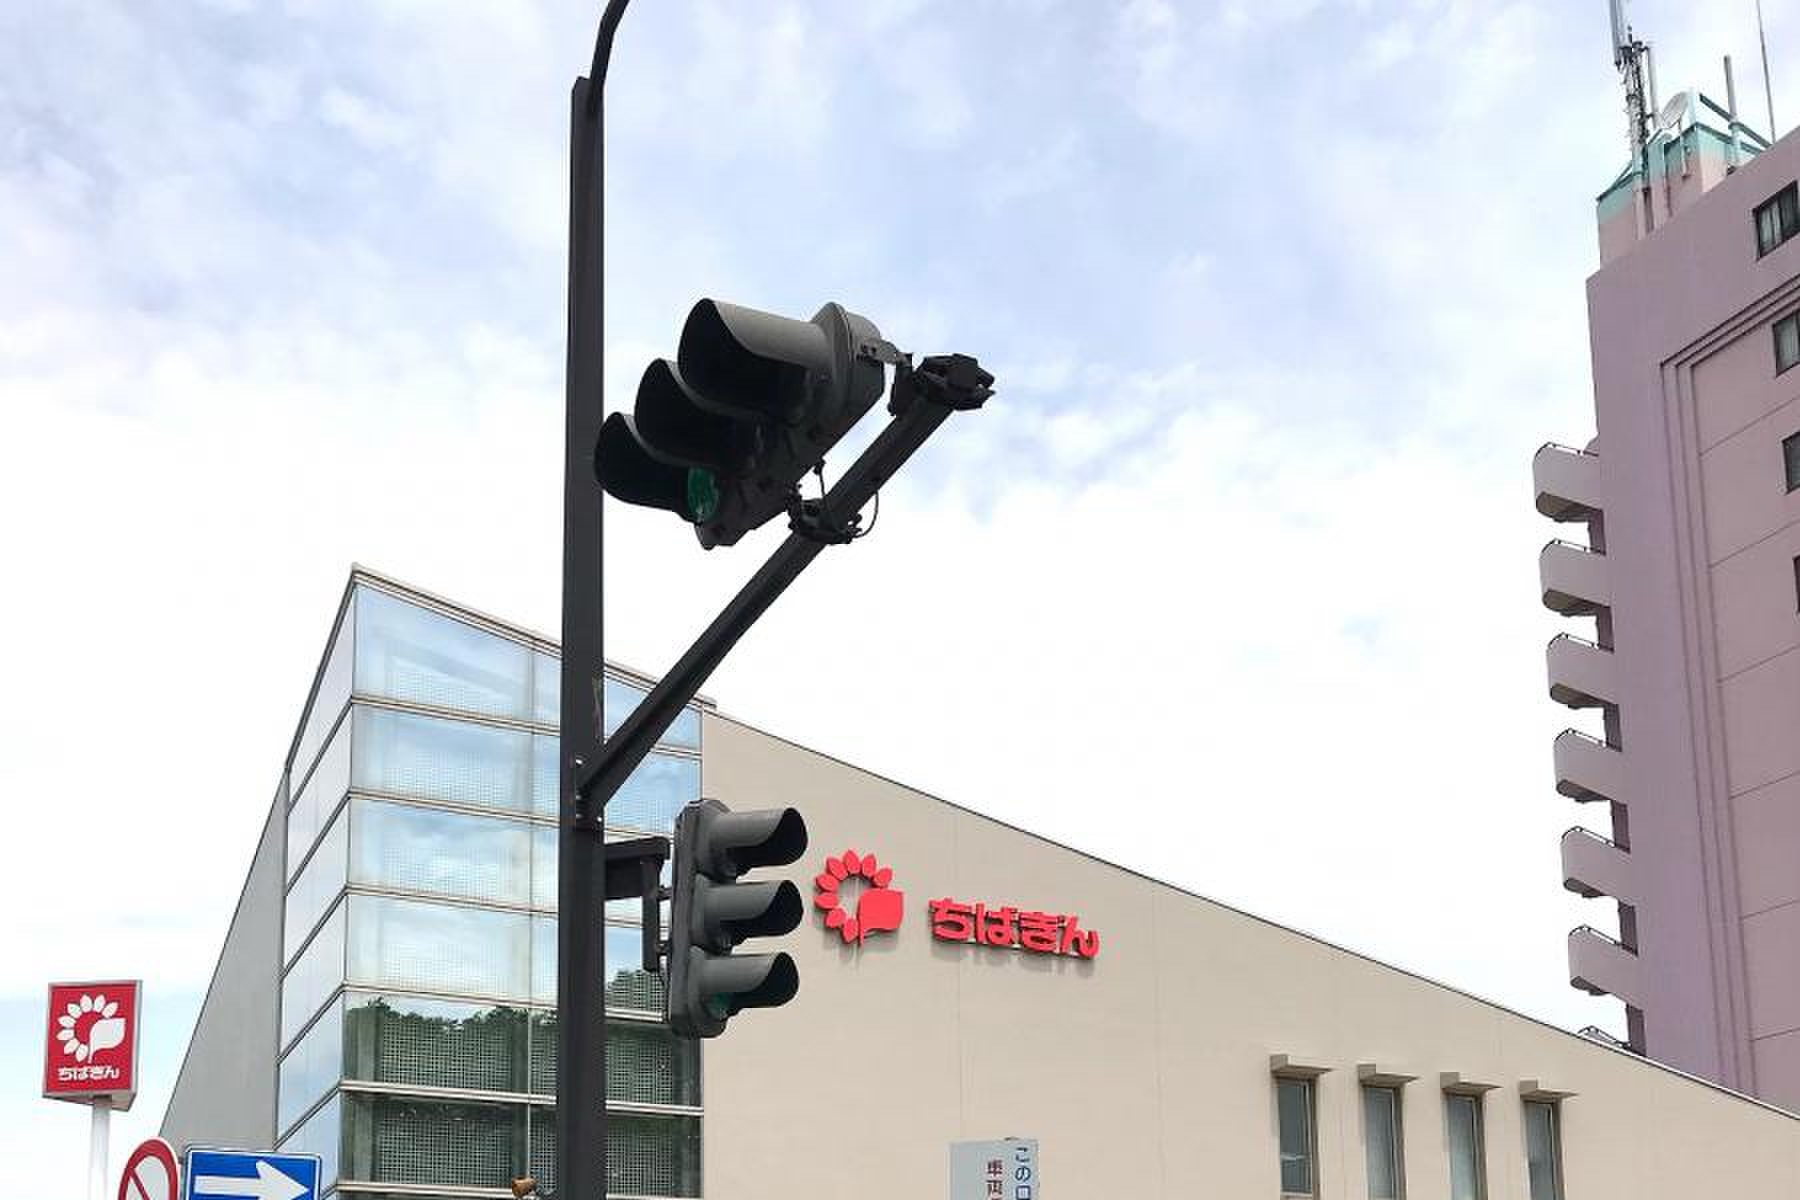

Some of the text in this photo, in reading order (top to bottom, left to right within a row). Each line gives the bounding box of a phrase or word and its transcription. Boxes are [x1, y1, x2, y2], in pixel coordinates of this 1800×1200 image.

[928, 897, 1100, 958] ちばぎん
[57, 1064, 120, 1081] ちばぎん
